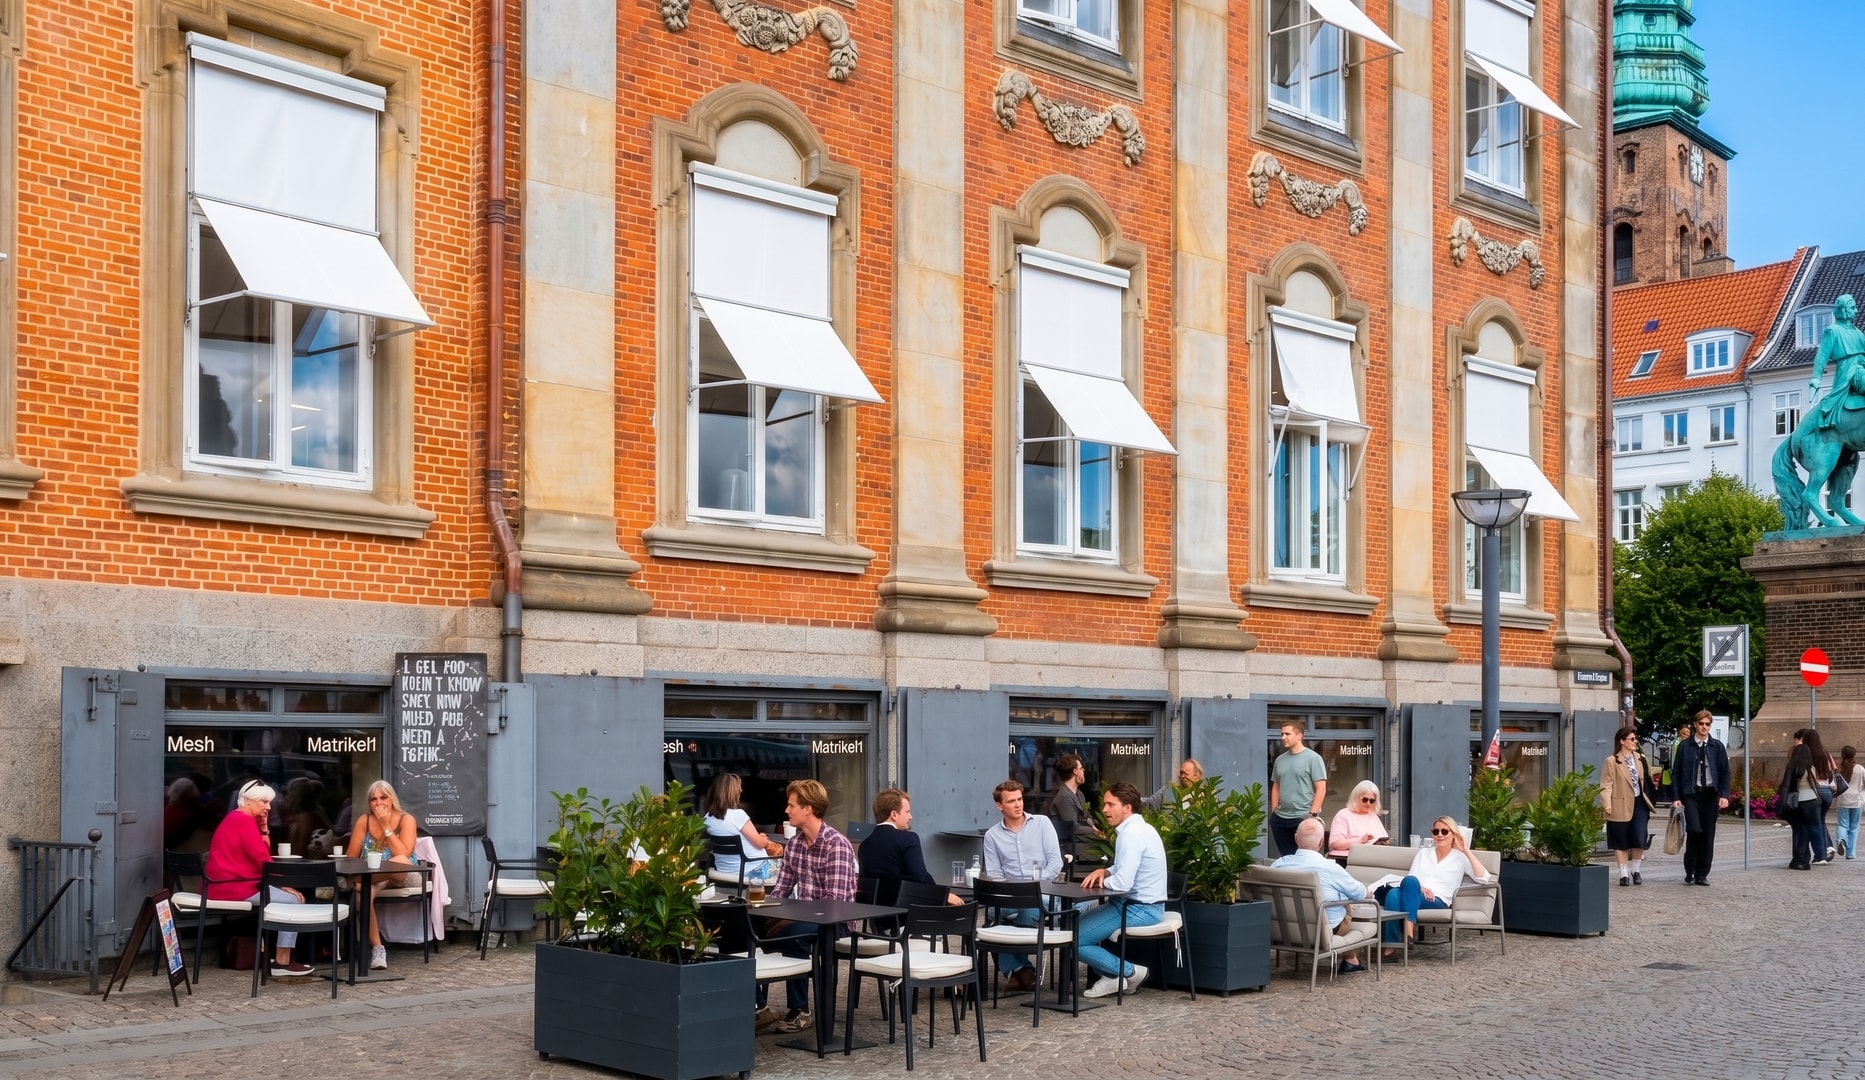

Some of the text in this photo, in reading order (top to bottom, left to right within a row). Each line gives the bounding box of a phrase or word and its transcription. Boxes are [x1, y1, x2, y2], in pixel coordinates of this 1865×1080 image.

[447, 676, 482, 692] KNOW
[167, 735, 215, 752] Mesh
[436, 728, 446, 745] A
[663, 739, 684, 753] esh
[812, 740, 863, 754] Matrikel1
